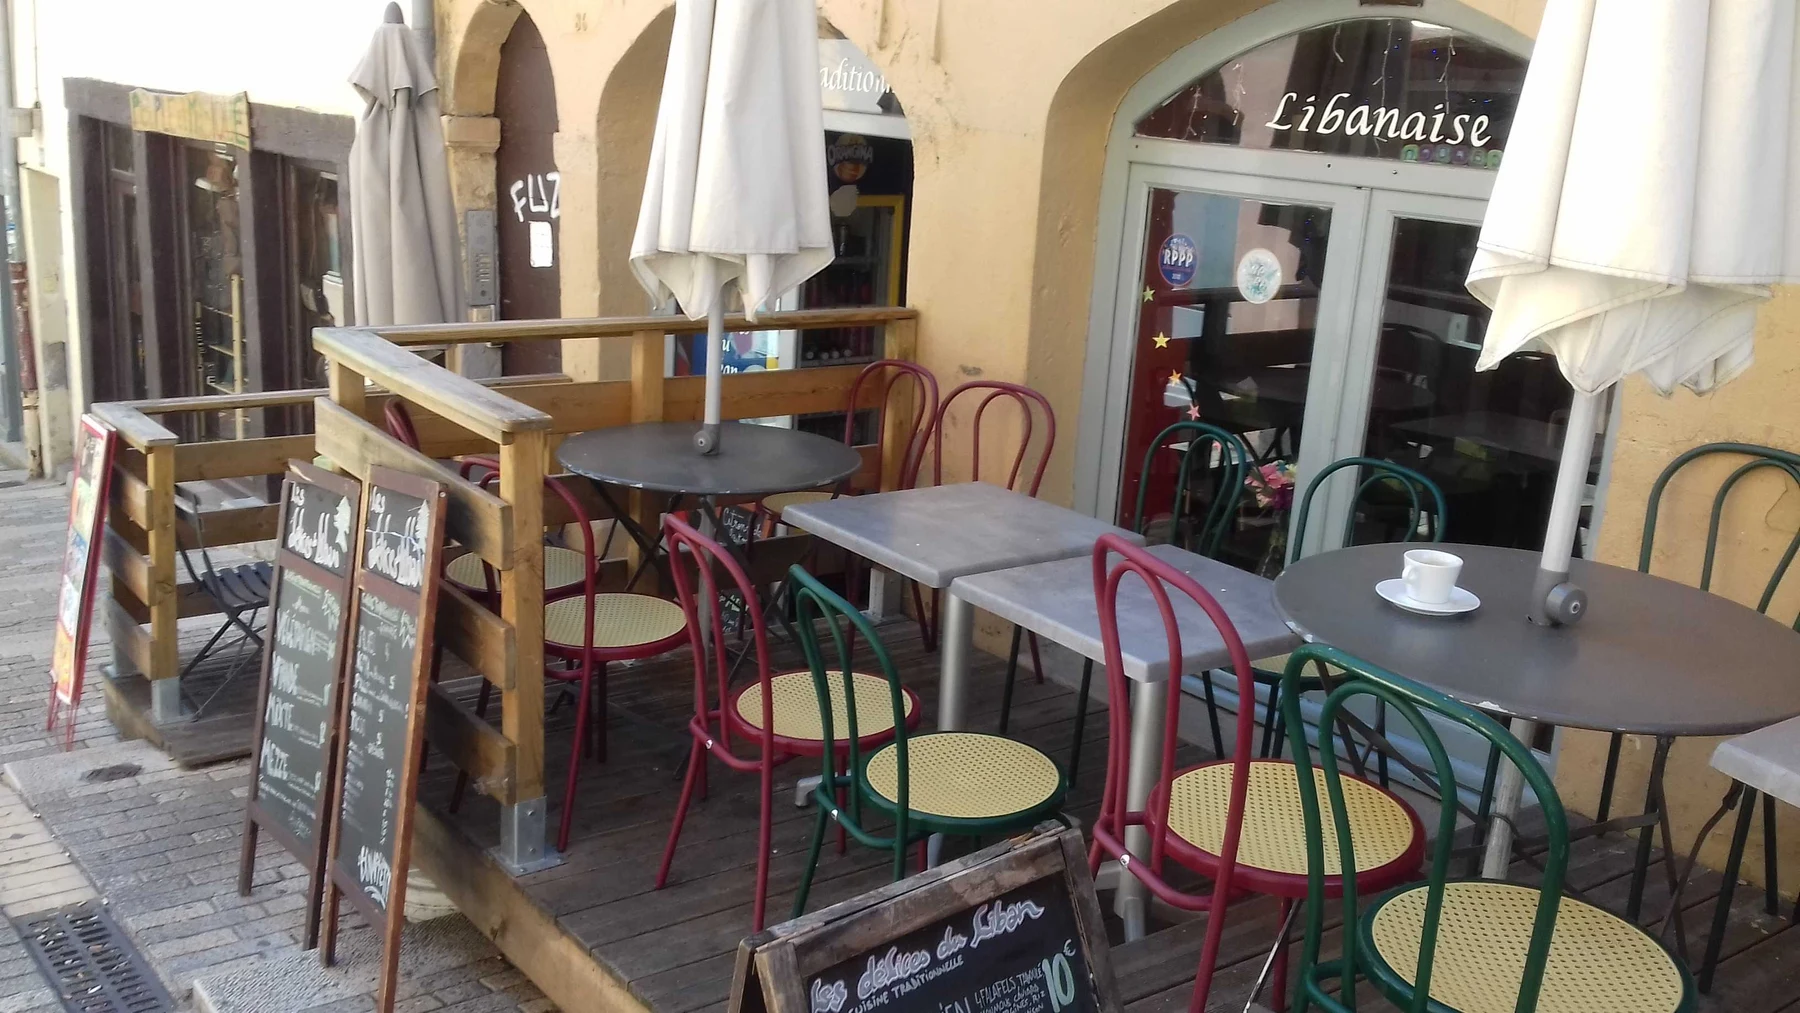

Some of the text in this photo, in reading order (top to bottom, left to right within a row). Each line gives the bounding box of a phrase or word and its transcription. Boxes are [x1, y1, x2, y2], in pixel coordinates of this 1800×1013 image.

[1265, 92, 1493, 148] Libanaise
[1163, 248, 1194, 268] RPPP
[936, 925, 968, 961] du
[970, 900, 1045, 948] Liban
